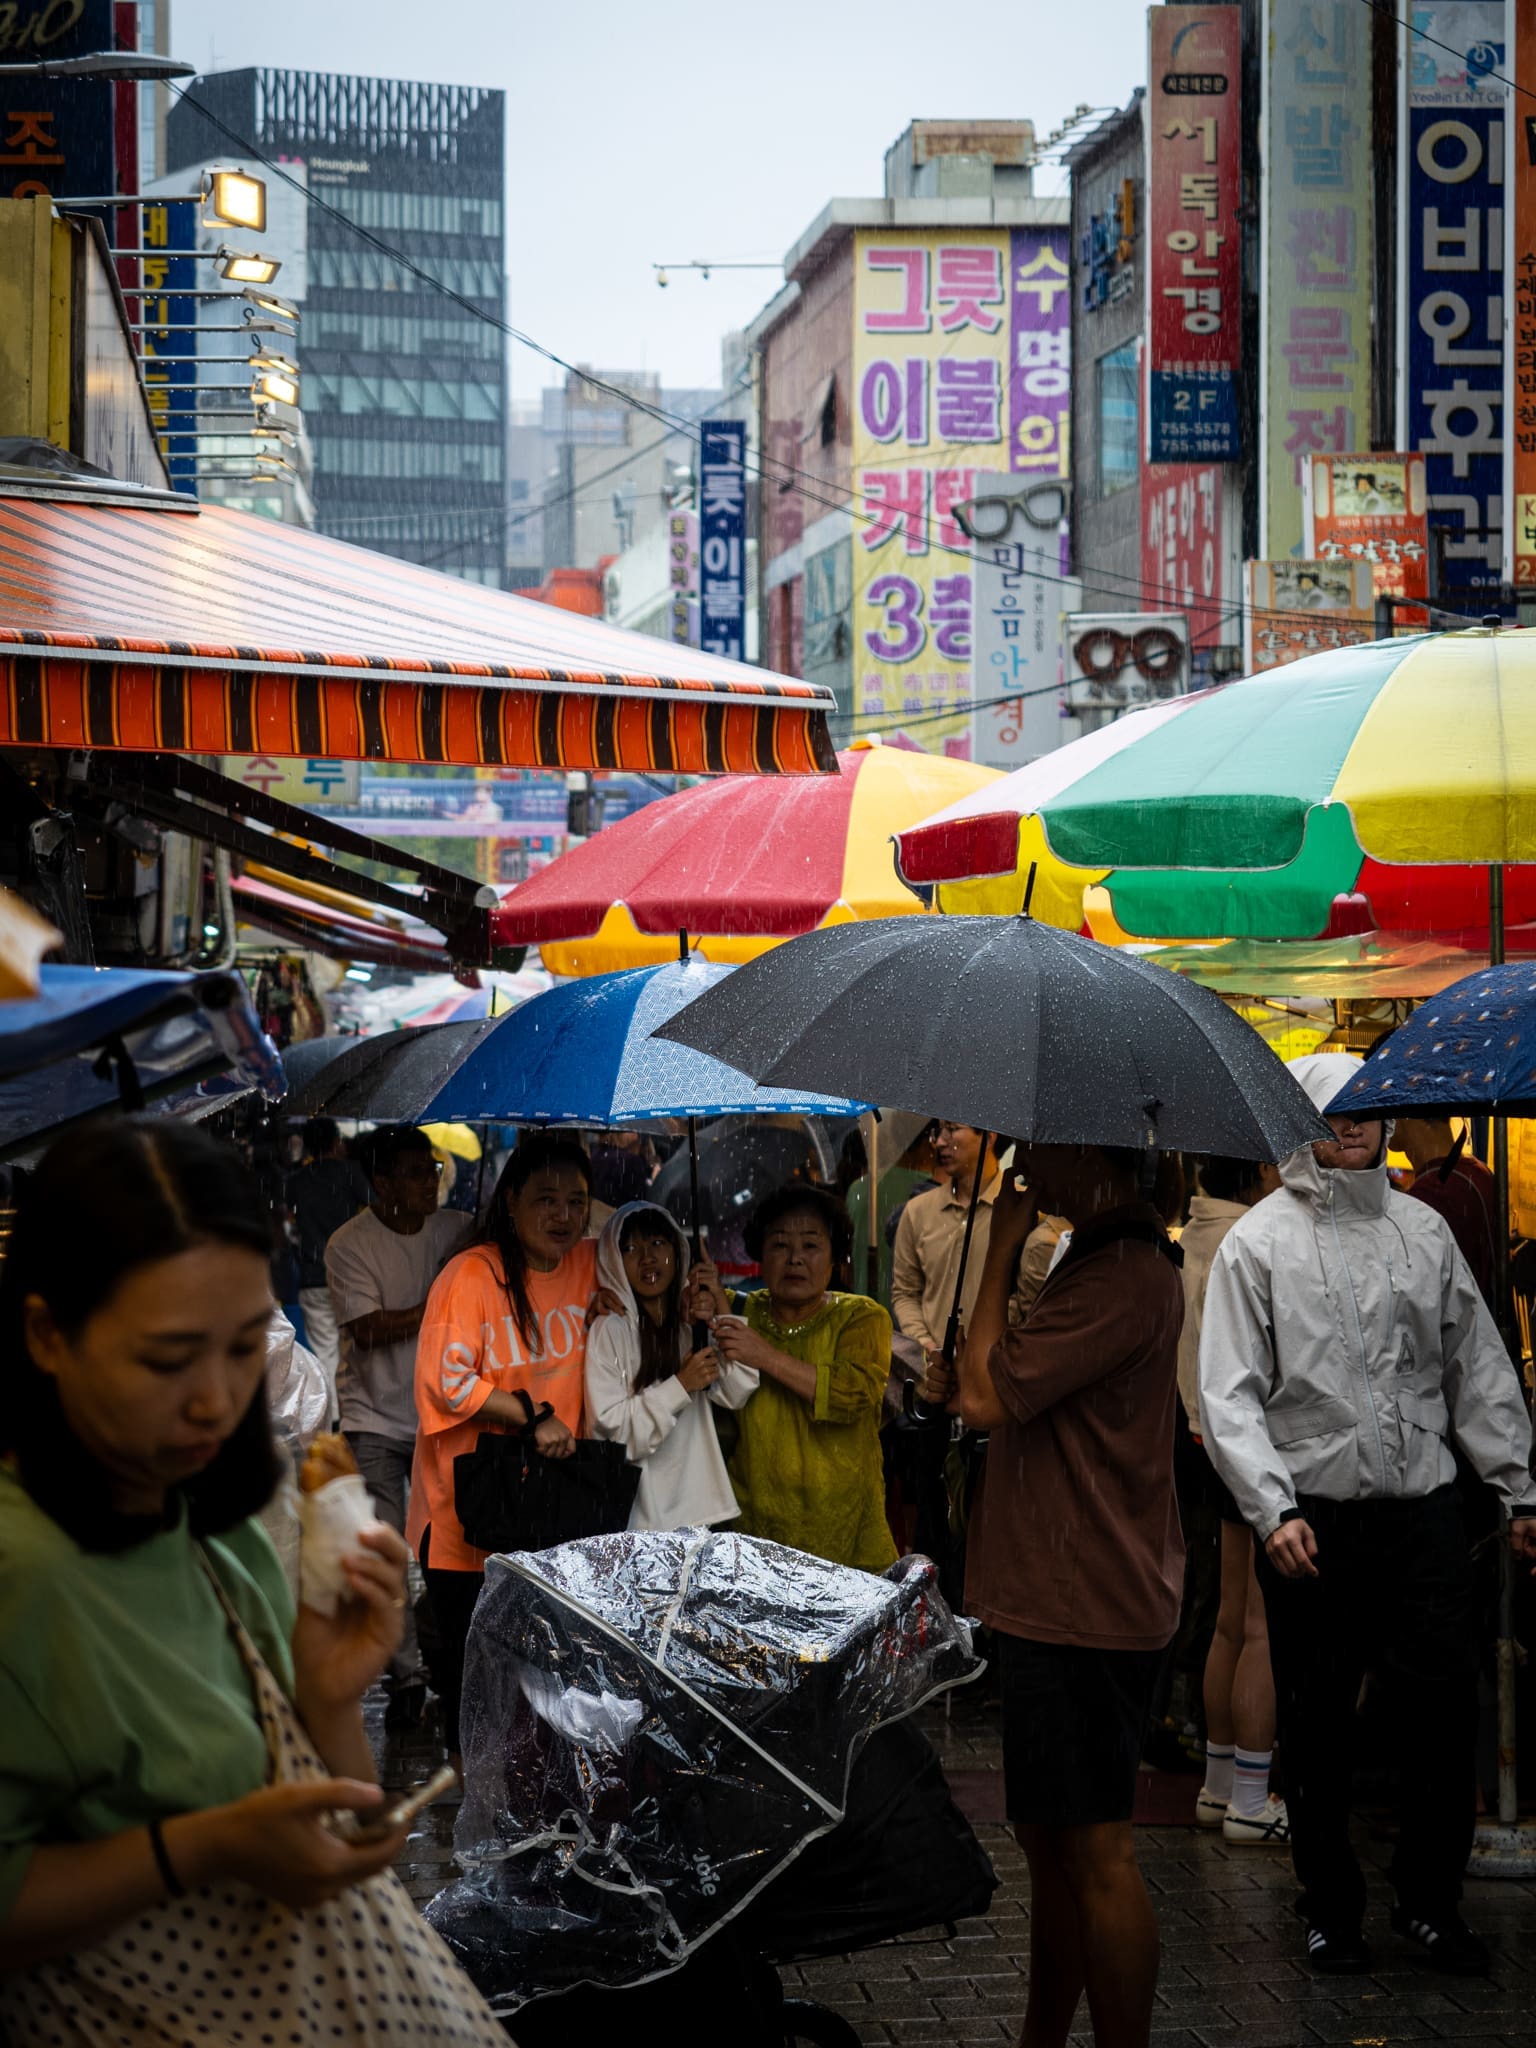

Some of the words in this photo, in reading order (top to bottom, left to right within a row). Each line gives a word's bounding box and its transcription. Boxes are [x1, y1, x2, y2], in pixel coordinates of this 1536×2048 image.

[1164, 117, 1226, 333] 서독안경
[864, 247, 1003, 333] 그릇
[861, 359, 1003, 446] 이불
